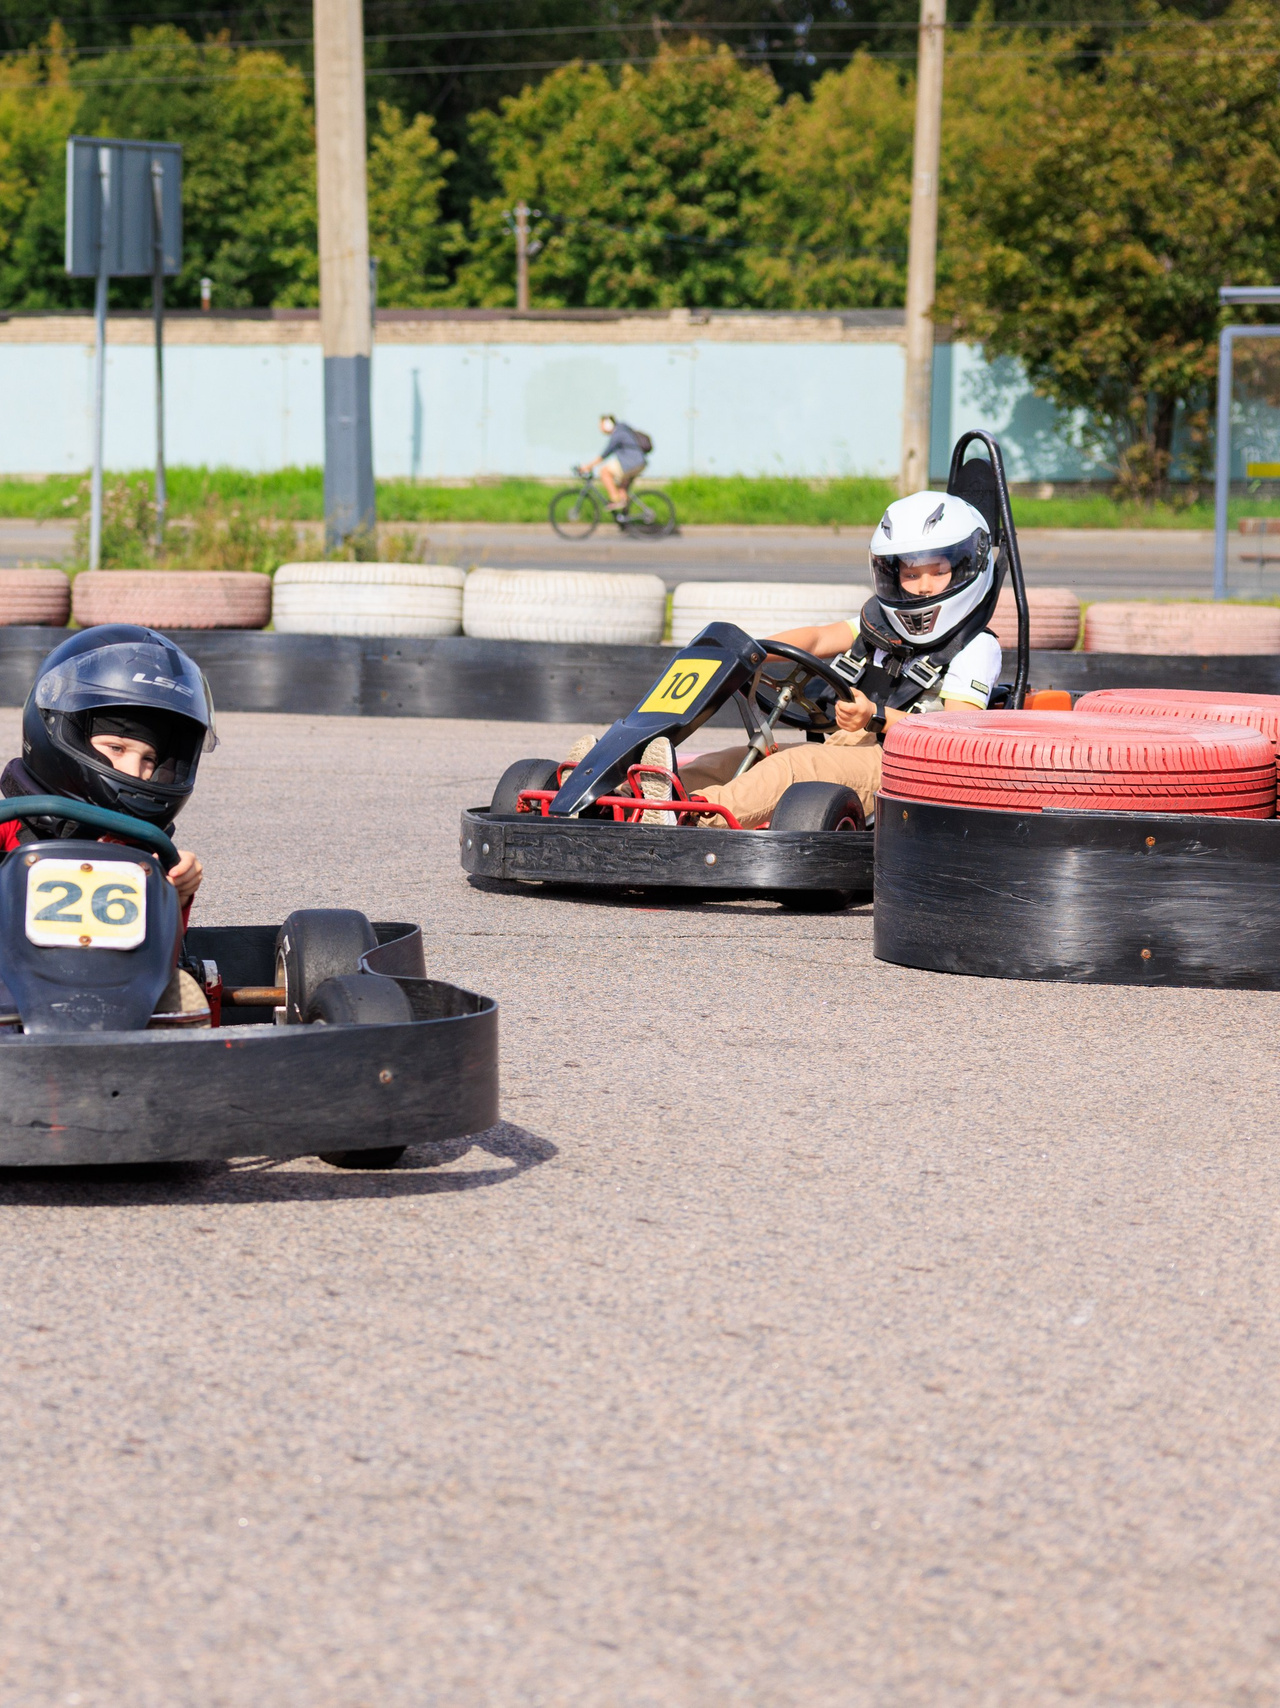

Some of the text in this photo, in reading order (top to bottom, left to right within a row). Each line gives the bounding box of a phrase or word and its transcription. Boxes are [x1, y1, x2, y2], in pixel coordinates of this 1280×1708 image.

[132, 672, 195, 698] LS2
[660, 672, 700, 700] 10
[33, 880, 139, 925] 26
